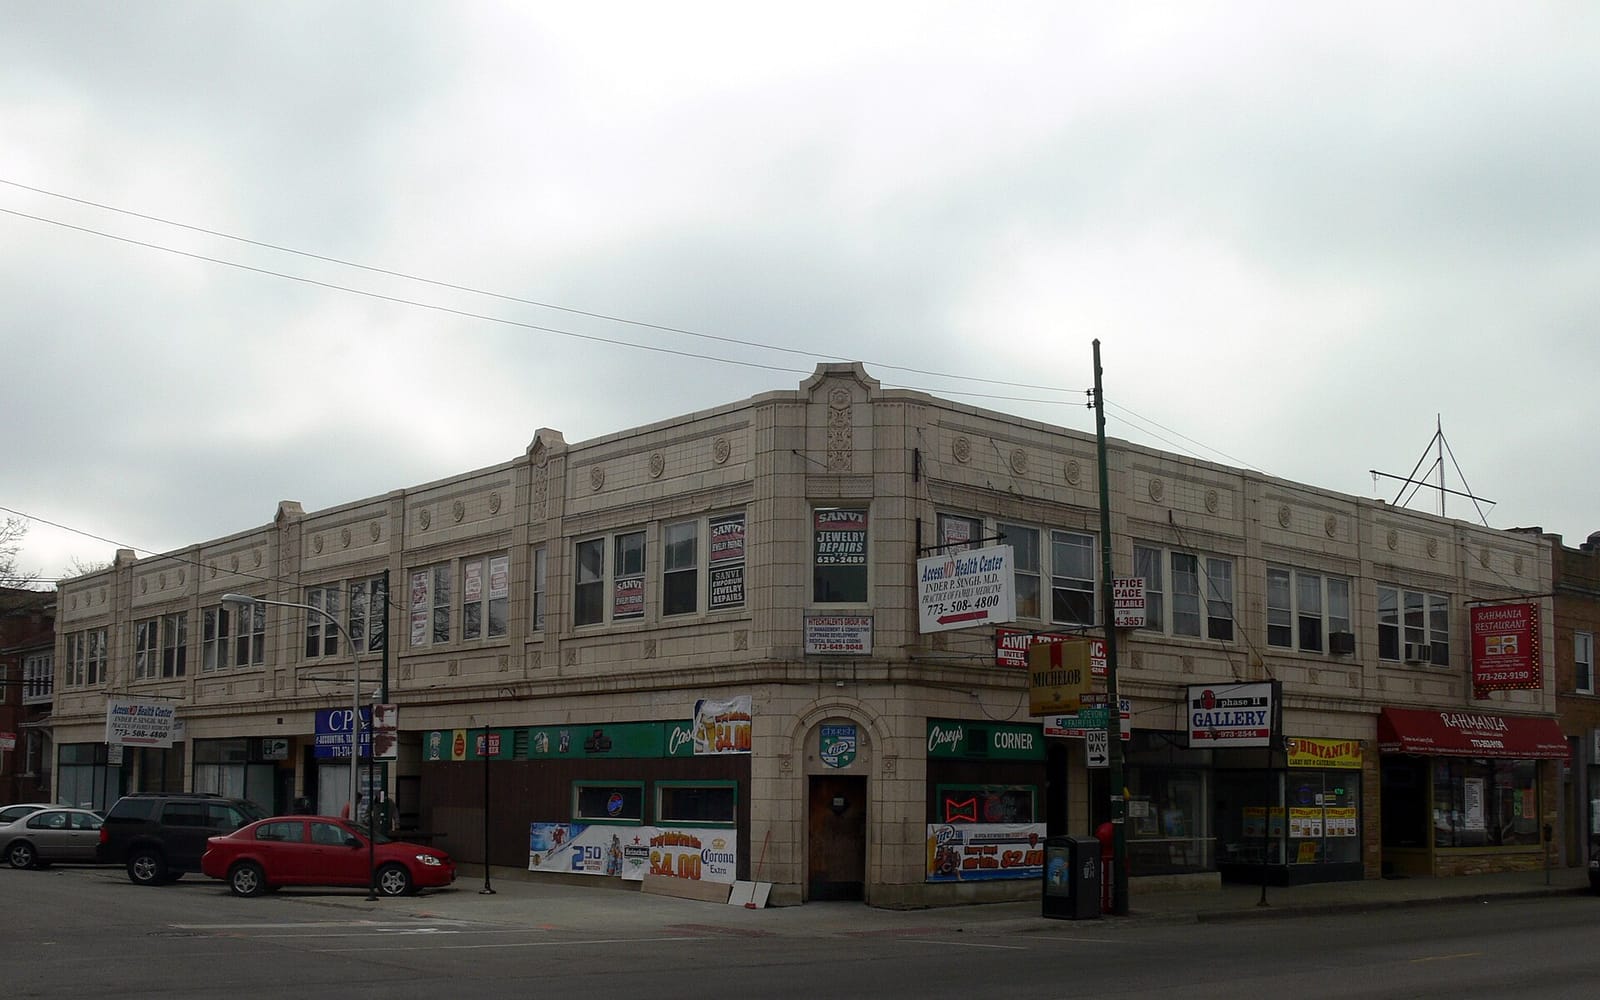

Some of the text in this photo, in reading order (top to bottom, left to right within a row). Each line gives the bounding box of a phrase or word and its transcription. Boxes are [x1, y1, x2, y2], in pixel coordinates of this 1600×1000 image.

[818, 512, 864, 523] SANVI
[712, 523, 744, 537] SANVI
[817, 531, 865, 542] JEWELRY
[819, 542, 863, 553] REPAIRS
[955, 557, 978, 577] Health
[979, 556, 1003, 572] Center
[715, 569, 740, 581] SANVI
[616, 580, 642, 591] SANVI
[925, 581, 948, 593] INDER
[983, 574, 999, 584] M.D.
[1113, 579, 1143, 587] FFICE
[712, 584, 743, 596] JEWELRY
[922, 592, 948, 604] PRACTICE
[955, 588, 974, 599] FAMILY
[975, 584, 1002, 596] MEDICINE
[1115, 589, 1142, 597] PACE
[712, 593, 743, 604] REPAIRS
[1114, 599, 1144, 607] AILABLE
[927, 595, 999, 616] 773- 508- 4800
[1478, 609, 1522, 620] RAHMANIA
[1115, 617, 1144, 625] 4-3557
[1475, 620, 1527, 632] RESTAURANT
[1002, 632, 1033, 649] AMIT
[1090, 642, 1106, 657] NC.
[1033, 669, 1081, 688] MICHELOB
[1477, 671, 1529, 681] 773-262-9190
[1221, 698, 1248, 708] phase
[137, 705, 154, 717] Health
[155, 706, 173, 718] Center
[1193, 711, 1267, 727] GALLERY
[1440, 712, 1509, 731] RAHMANIA
[669, 726, 695, 755] Cas
[928, 725, 964, 752] Casey's
[994, 731, 1033, 750] CORNER
[1088, 732, 1106, 742] ONE
[1088, 743, 1106, 753] WAY
[701, 848, 734, 864] Corona
[650, 851, 702, 880] $4.00
[710, 865, 727, 875] Extra
